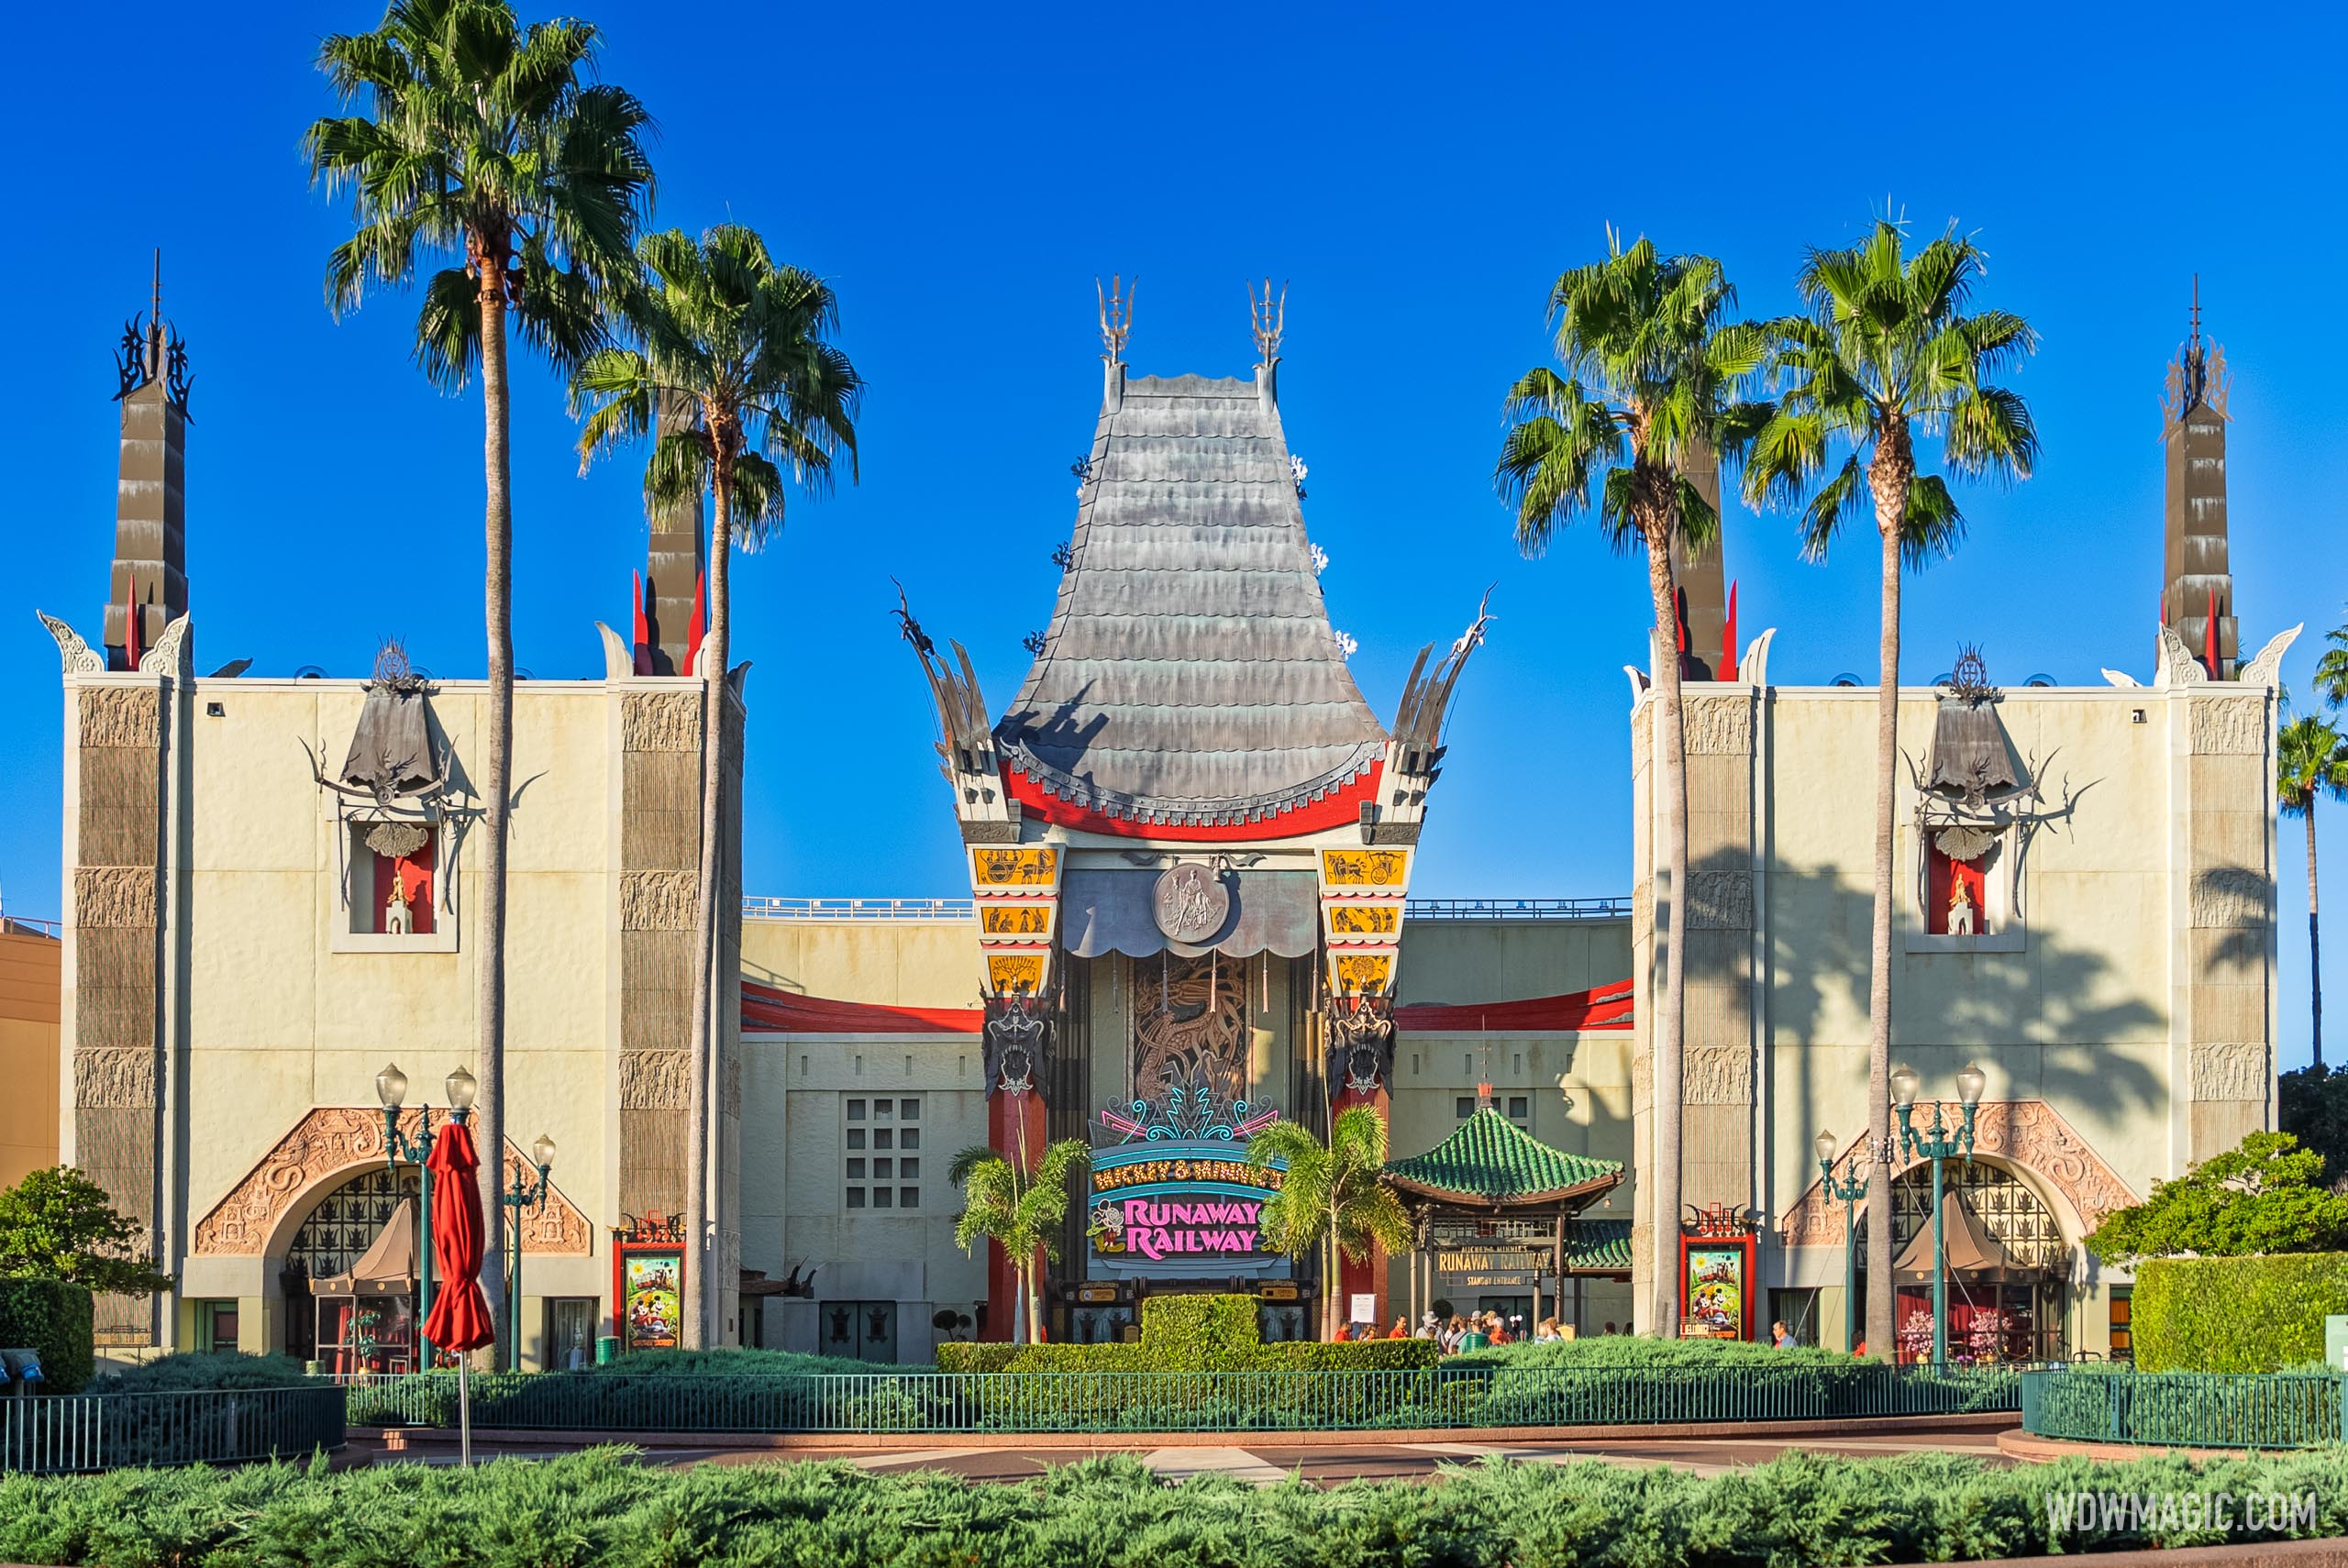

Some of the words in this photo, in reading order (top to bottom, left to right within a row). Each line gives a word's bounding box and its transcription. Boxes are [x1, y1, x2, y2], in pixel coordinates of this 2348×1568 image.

[1093, 1161, 1171, 1191] MICKEY
[1174, 1159, 1191, 1181] &
[1124, 1199, 1261, 1226] RUNAWAY
[1126, 1227, 1257, 1261] RAILWAY
[1439, 1253, 1494, 1271] RUNAWAY
[1501, 1253, 1550, 1270] RAILWAY
